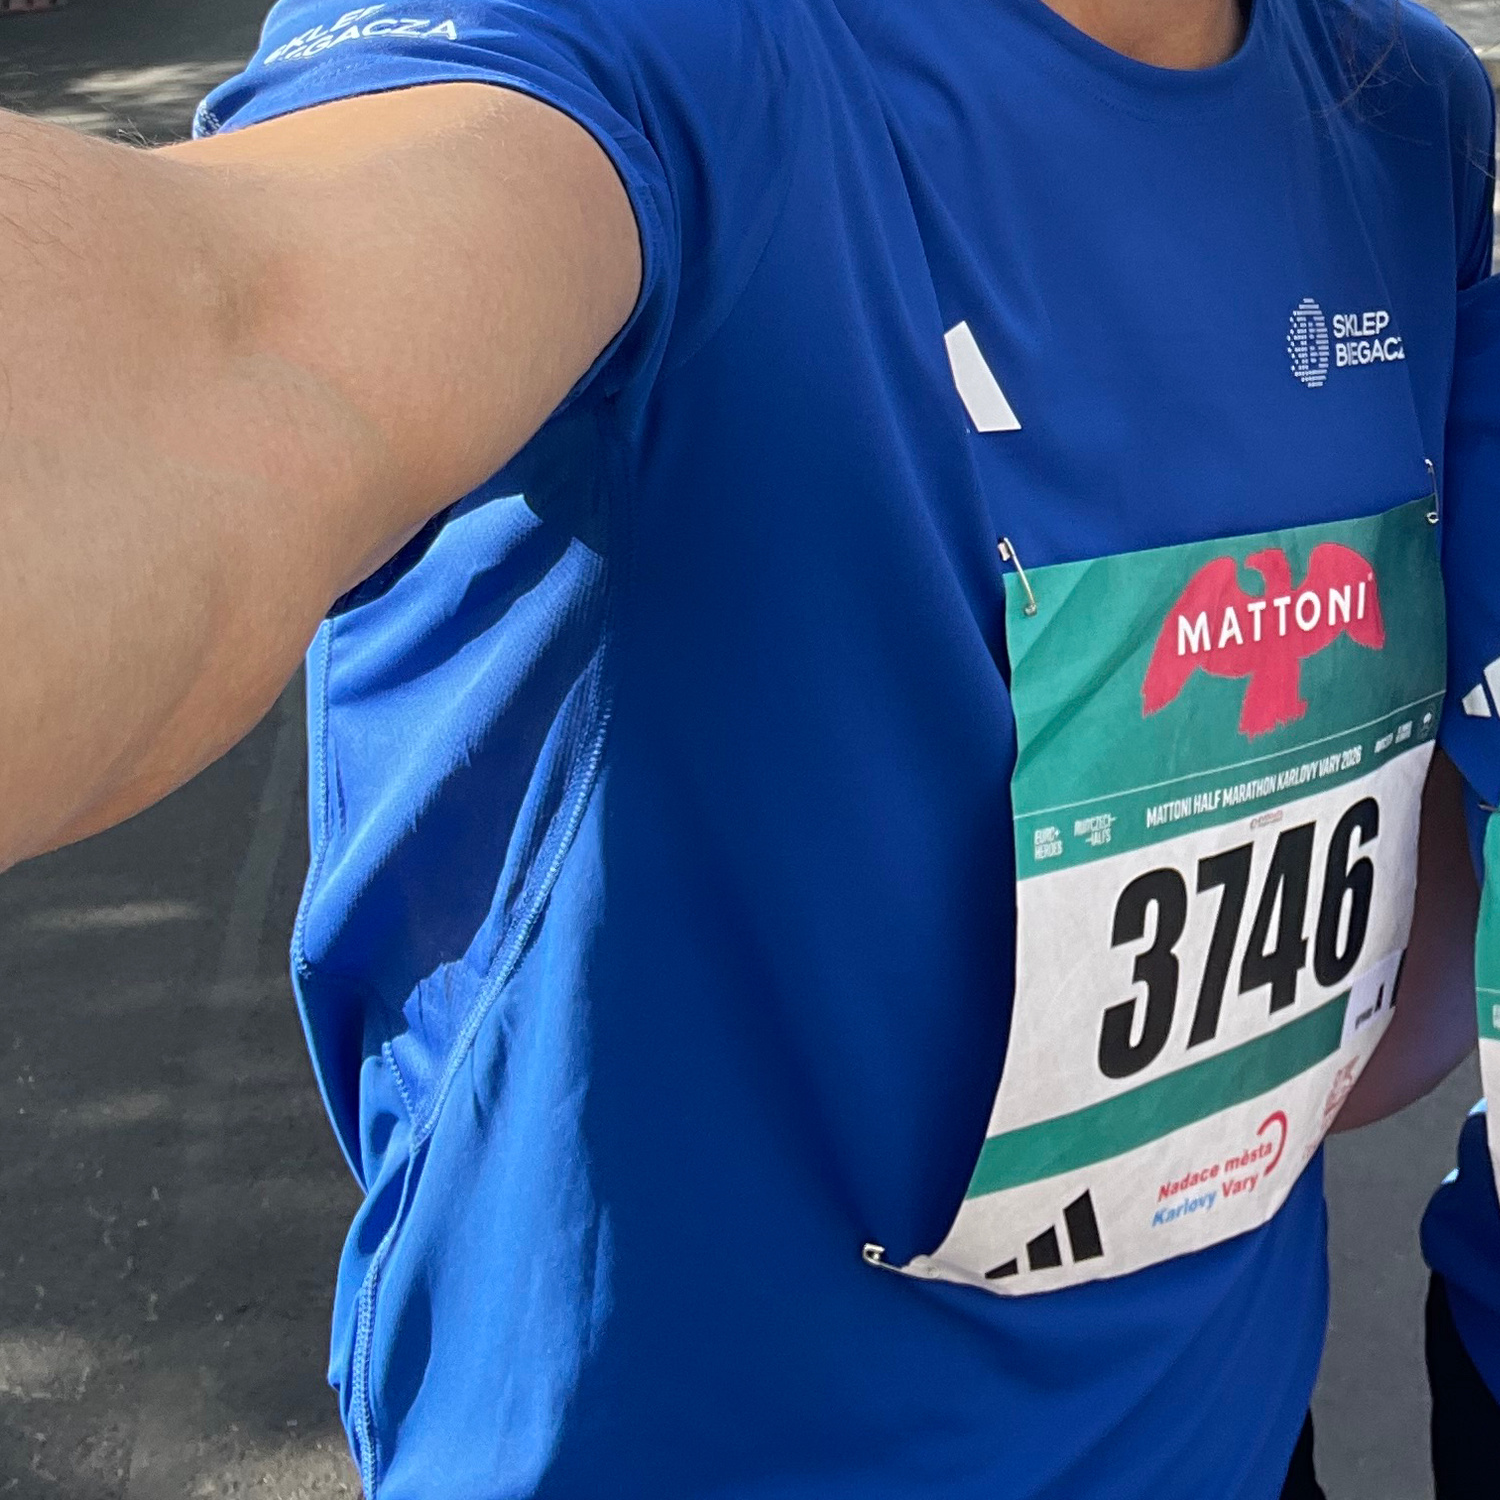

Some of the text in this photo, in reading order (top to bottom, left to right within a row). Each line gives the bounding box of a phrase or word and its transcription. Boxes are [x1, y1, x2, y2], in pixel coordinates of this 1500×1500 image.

[1332, 310, 1390, 339] SKLEP
[1177, 581, 1367, 656] MATTONI
[1146, 745, 1363, 829] MATTONI HALF MARATHON KARLOVY VARY 2026
[1098, 796, 1380, 1079] 3746
[1152, 1172, 1260, 1229] Karlovy Vary
[1157, 1141, 1274, 1205] Nadace města
